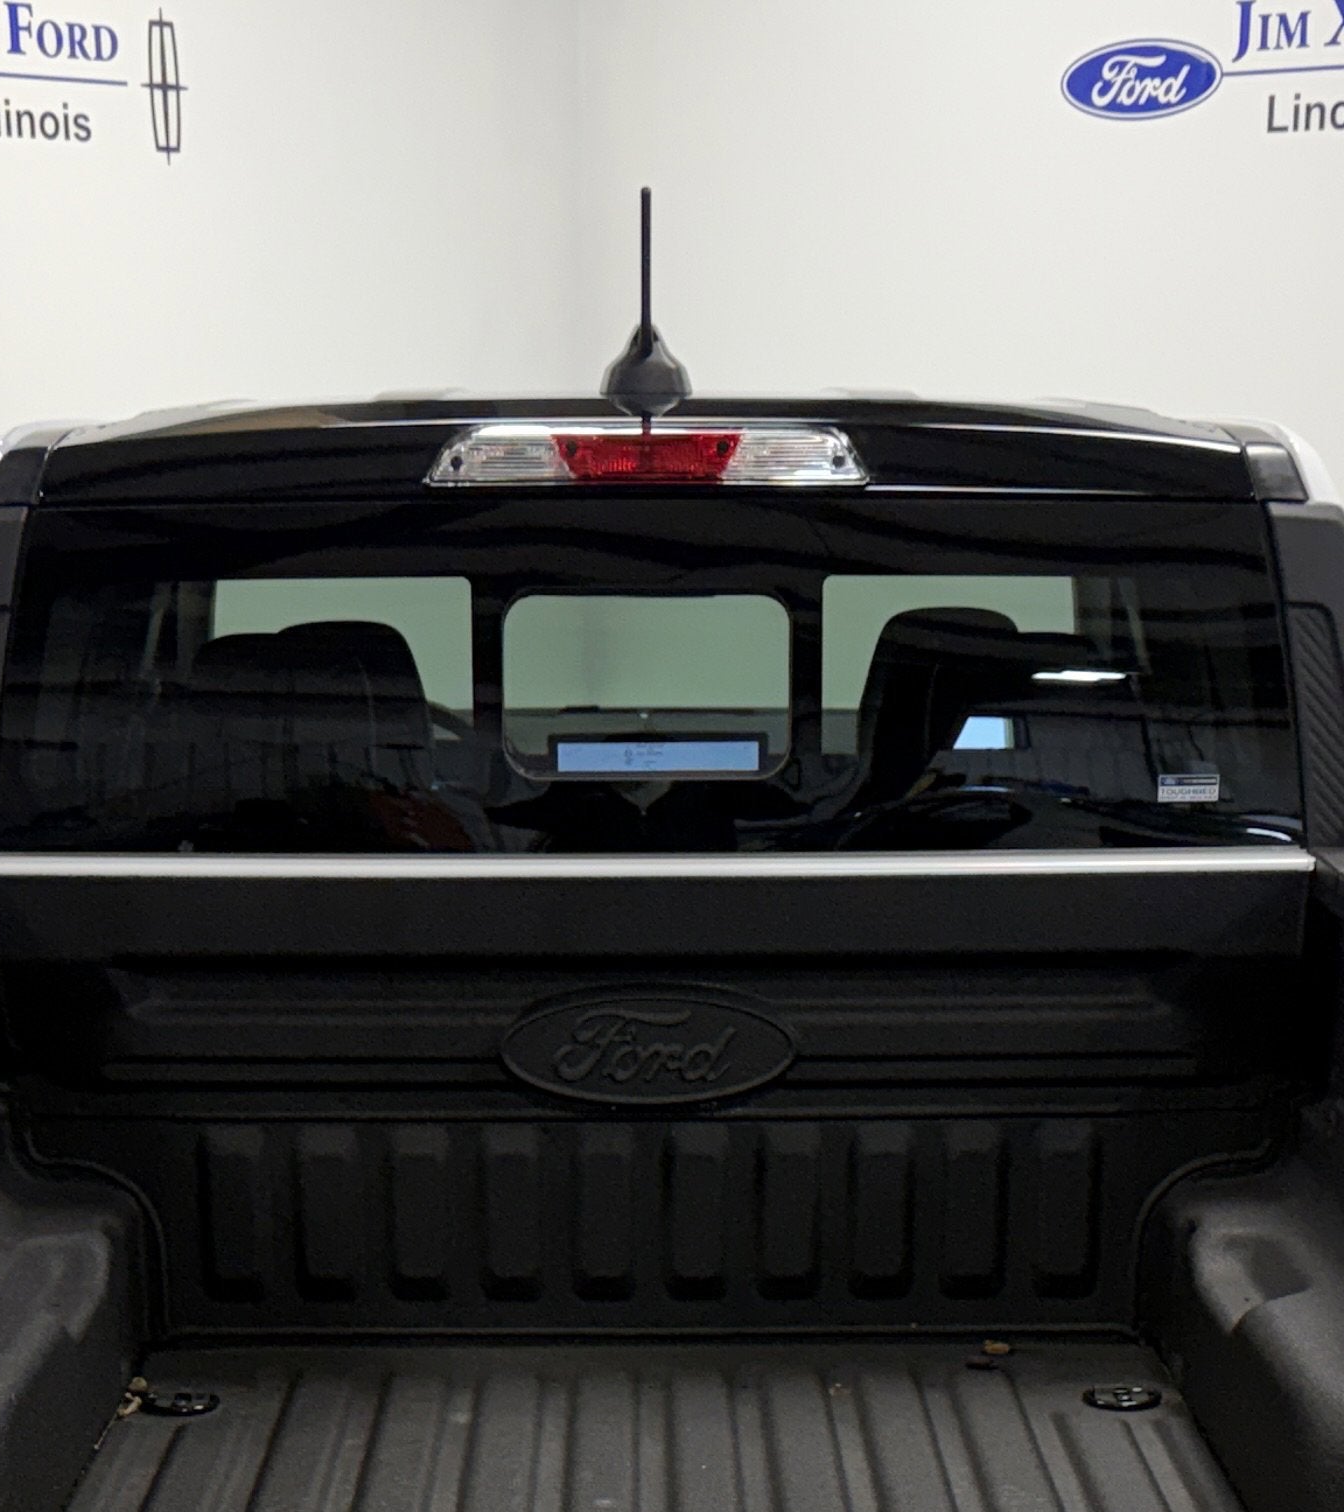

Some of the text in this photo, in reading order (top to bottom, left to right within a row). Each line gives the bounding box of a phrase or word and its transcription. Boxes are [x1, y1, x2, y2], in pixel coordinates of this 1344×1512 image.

[3, 1, 118, 61] FORD
[1232, 0, 1311, 63] JIM
[1091, 54, 1187, 108] Ford
[555, 1007, 737, 1082] Ford
